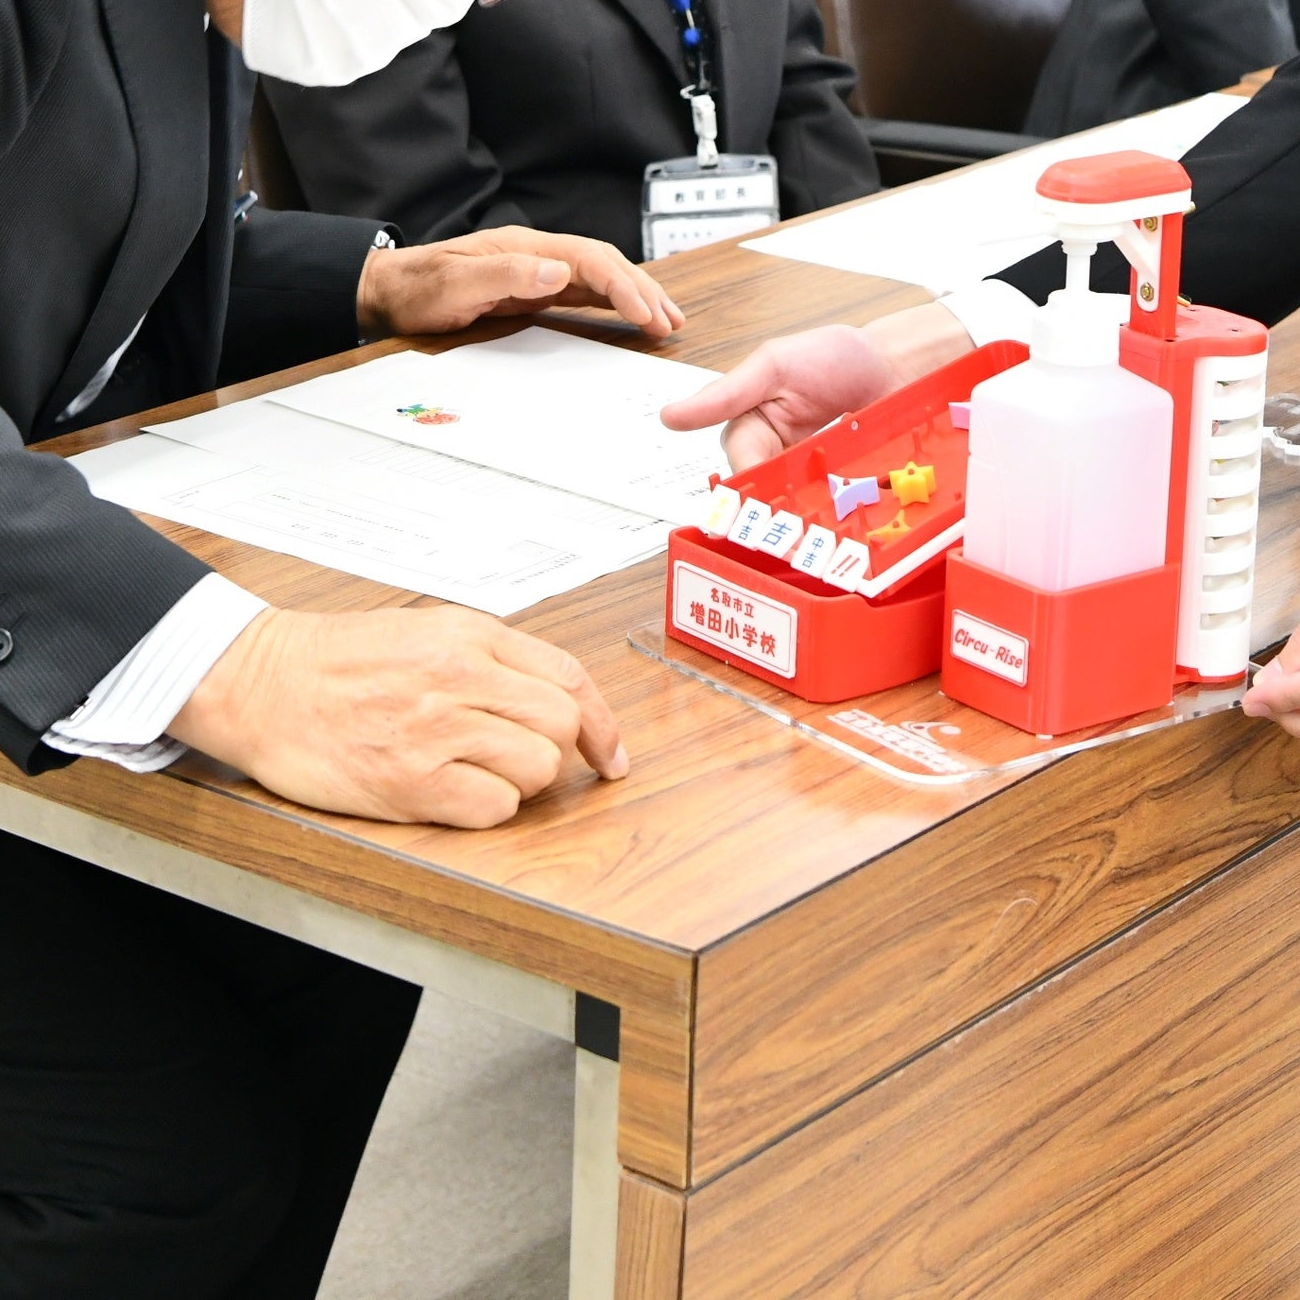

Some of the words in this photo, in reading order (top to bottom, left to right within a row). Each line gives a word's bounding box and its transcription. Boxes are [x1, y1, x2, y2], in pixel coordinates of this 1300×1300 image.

[739, 510, 760, 540] 中吉
[762, 522, 792, 546] 吉
[802, 537, 824, 568] 中吉
[711, 587, 754, 618] 名取市立
[690, 601, 776, 658] 増田小学校
[954, 628, 1023, 668] Circu-Rise
